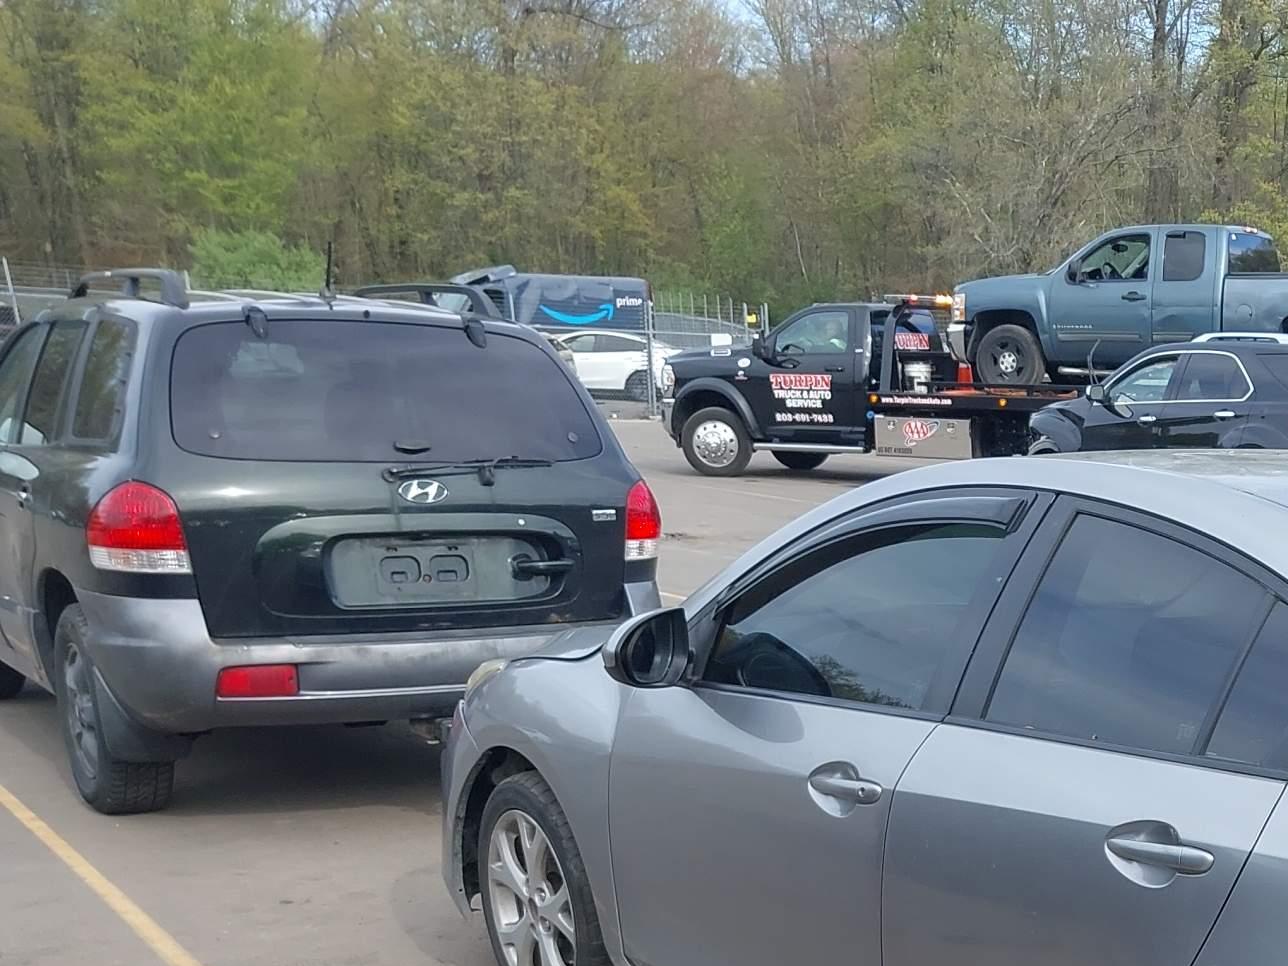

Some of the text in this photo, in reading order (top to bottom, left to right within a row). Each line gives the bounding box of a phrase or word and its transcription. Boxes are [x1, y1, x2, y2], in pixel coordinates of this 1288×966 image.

[616, 297, 643, 308] prime
[894, 333, 929, 349] URPIN
[769, 374, 832, 389] TURPIN
[774, 390, 832, 400] TRUCK & AUTO
[785, 399, 823, 408] SERVICE
